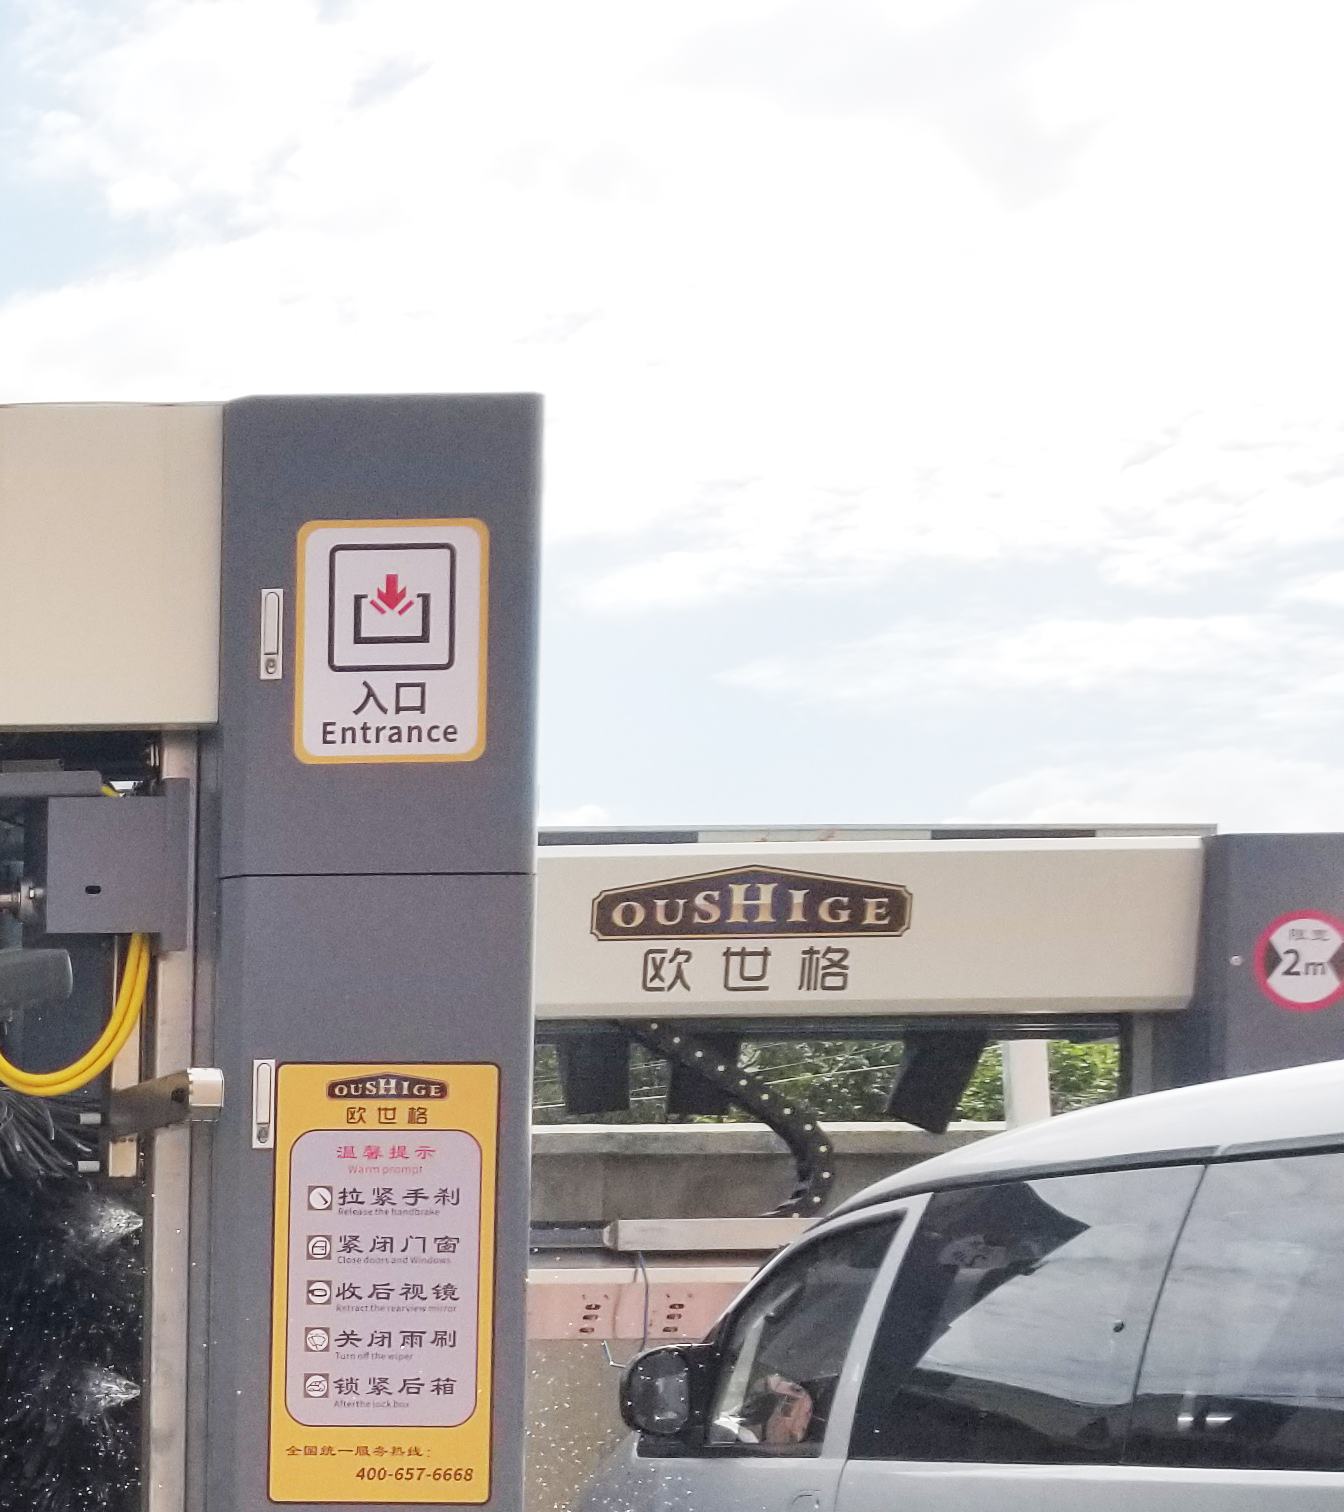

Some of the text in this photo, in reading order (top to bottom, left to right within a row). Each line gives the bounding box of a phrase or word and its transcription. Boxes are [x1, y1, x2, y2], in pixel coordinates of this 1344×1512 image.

[352, 680, 427, 715] 入口
[321, 721, 459, 745] Entrance
[612, 883, 891, 928] OUSHIGE
[642, 945, 850, 992] 欧世格
[1281, 948, 1326, 976] 2m
[334, 1078, 441, 1096] OUSHIGE
[346, 1106, 428, 1124] 欧世格
[336, 1145, 437, 1159] 温馨提示
[337, 1187, 460, 1206] 拉紧手刹
[336, 1235, 460, 1253] 紧闭门窗
[335, 1282, 460, 1301] 收后视镜
[334, 1329, 457, 1348] 关闭雨刷
[333, 1377, 457, 1395] 锁紧后箱
[355, 1467, 474, 1482] 400-657-6668
